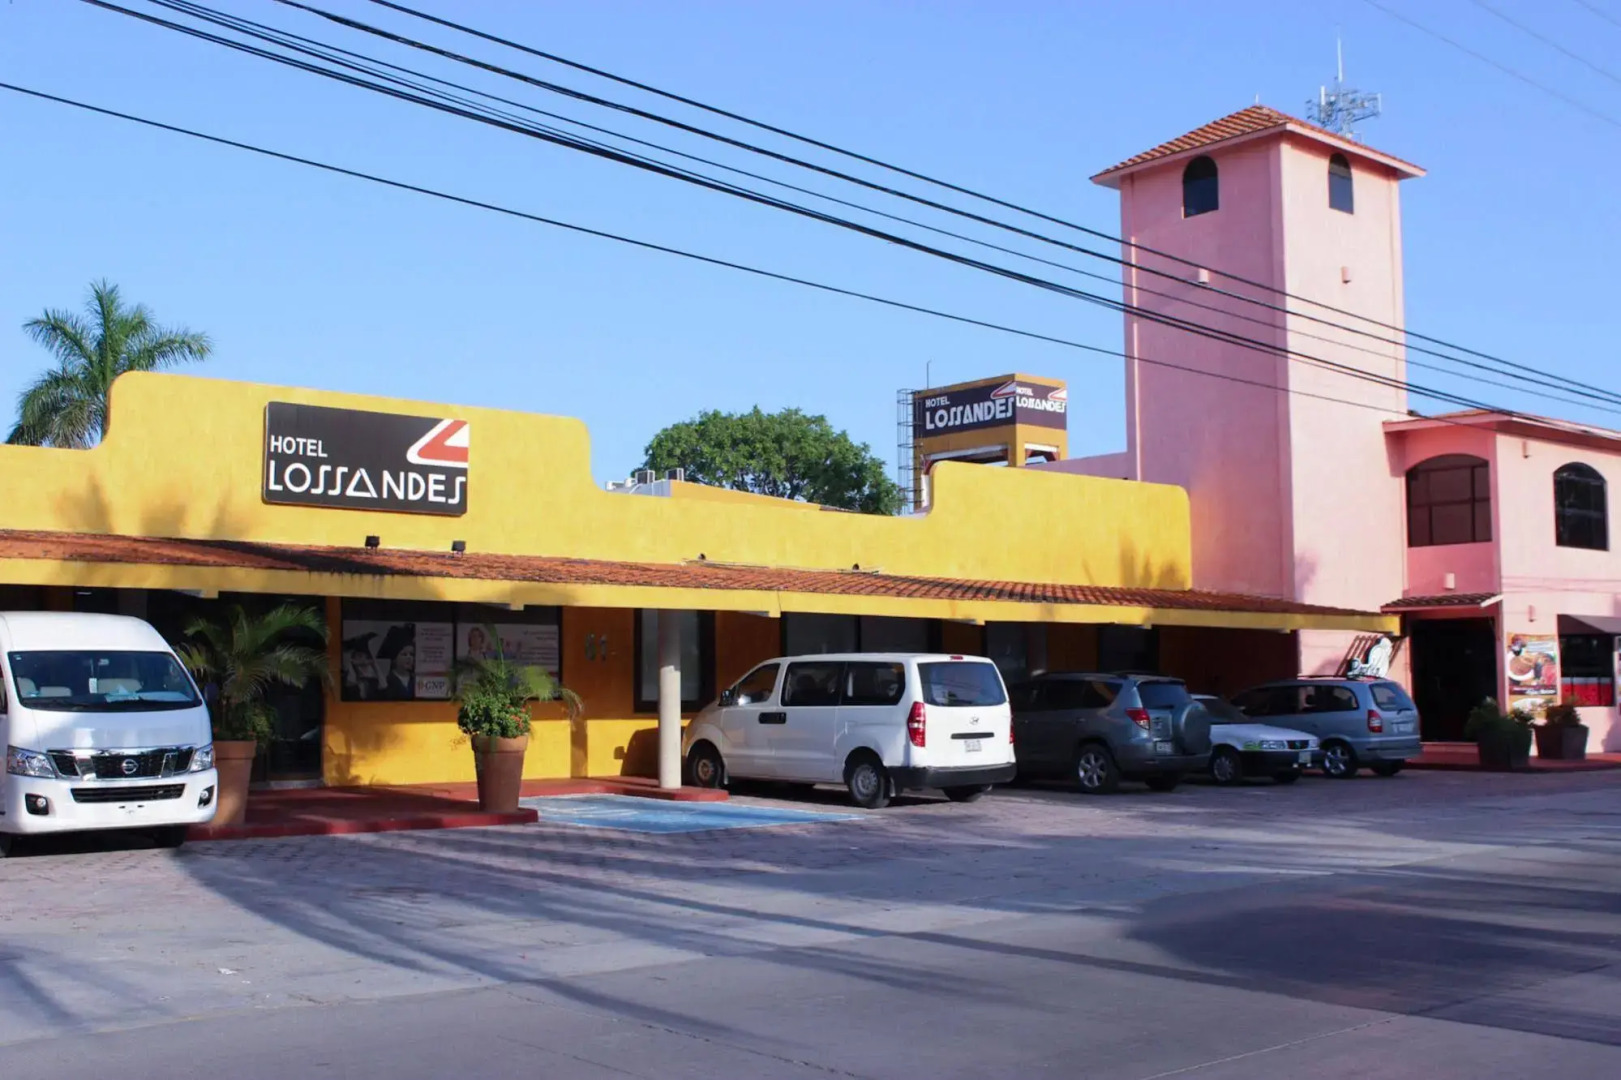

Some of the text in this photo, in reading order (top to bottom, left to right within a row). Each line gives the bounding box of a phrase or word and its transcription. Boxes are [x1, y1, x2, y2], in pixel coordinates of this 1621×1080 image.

[1016, 386, 1033, 396] HOTEL
[926, 396, 949, 408] HOTEL
[926, 397, 1014, 430] LOSSANDES
[270, 435, 328, 457] HOTEL
[269, 460, 466, 504] LOSSANDES
[424, 680, 445, 690] GNP
